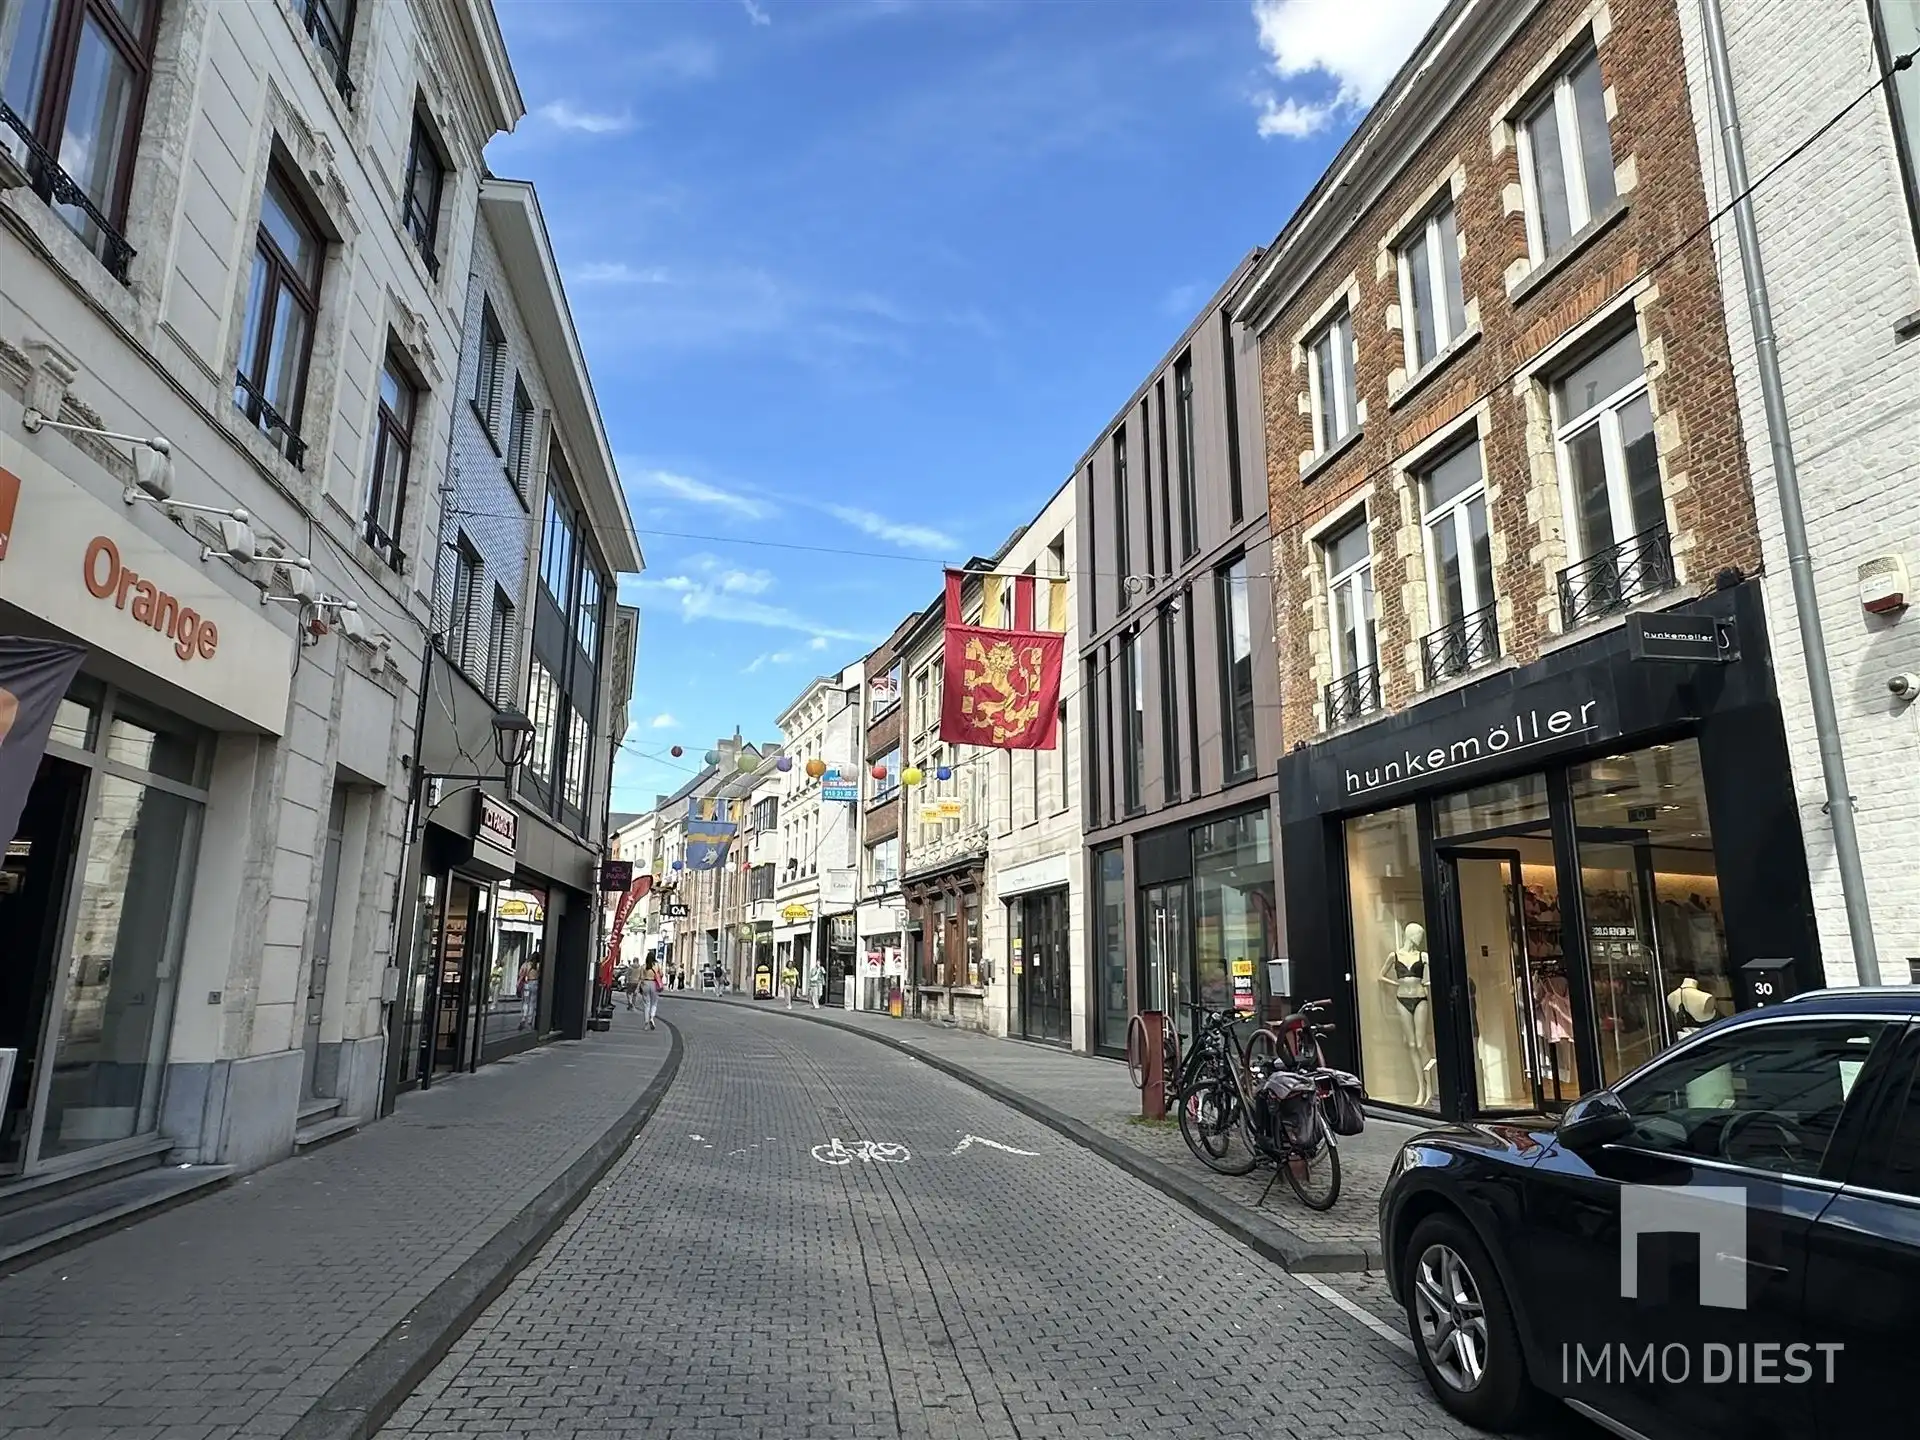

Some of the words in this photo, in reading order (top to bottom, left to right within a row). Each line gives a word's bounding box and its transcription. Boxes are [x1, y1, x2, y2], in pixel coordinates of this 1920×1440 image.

[84, 535, 218, 661] Orange
[1345, 699, 1597, 793] hunkemöller
[1754, 982, 1773, 996] 30
